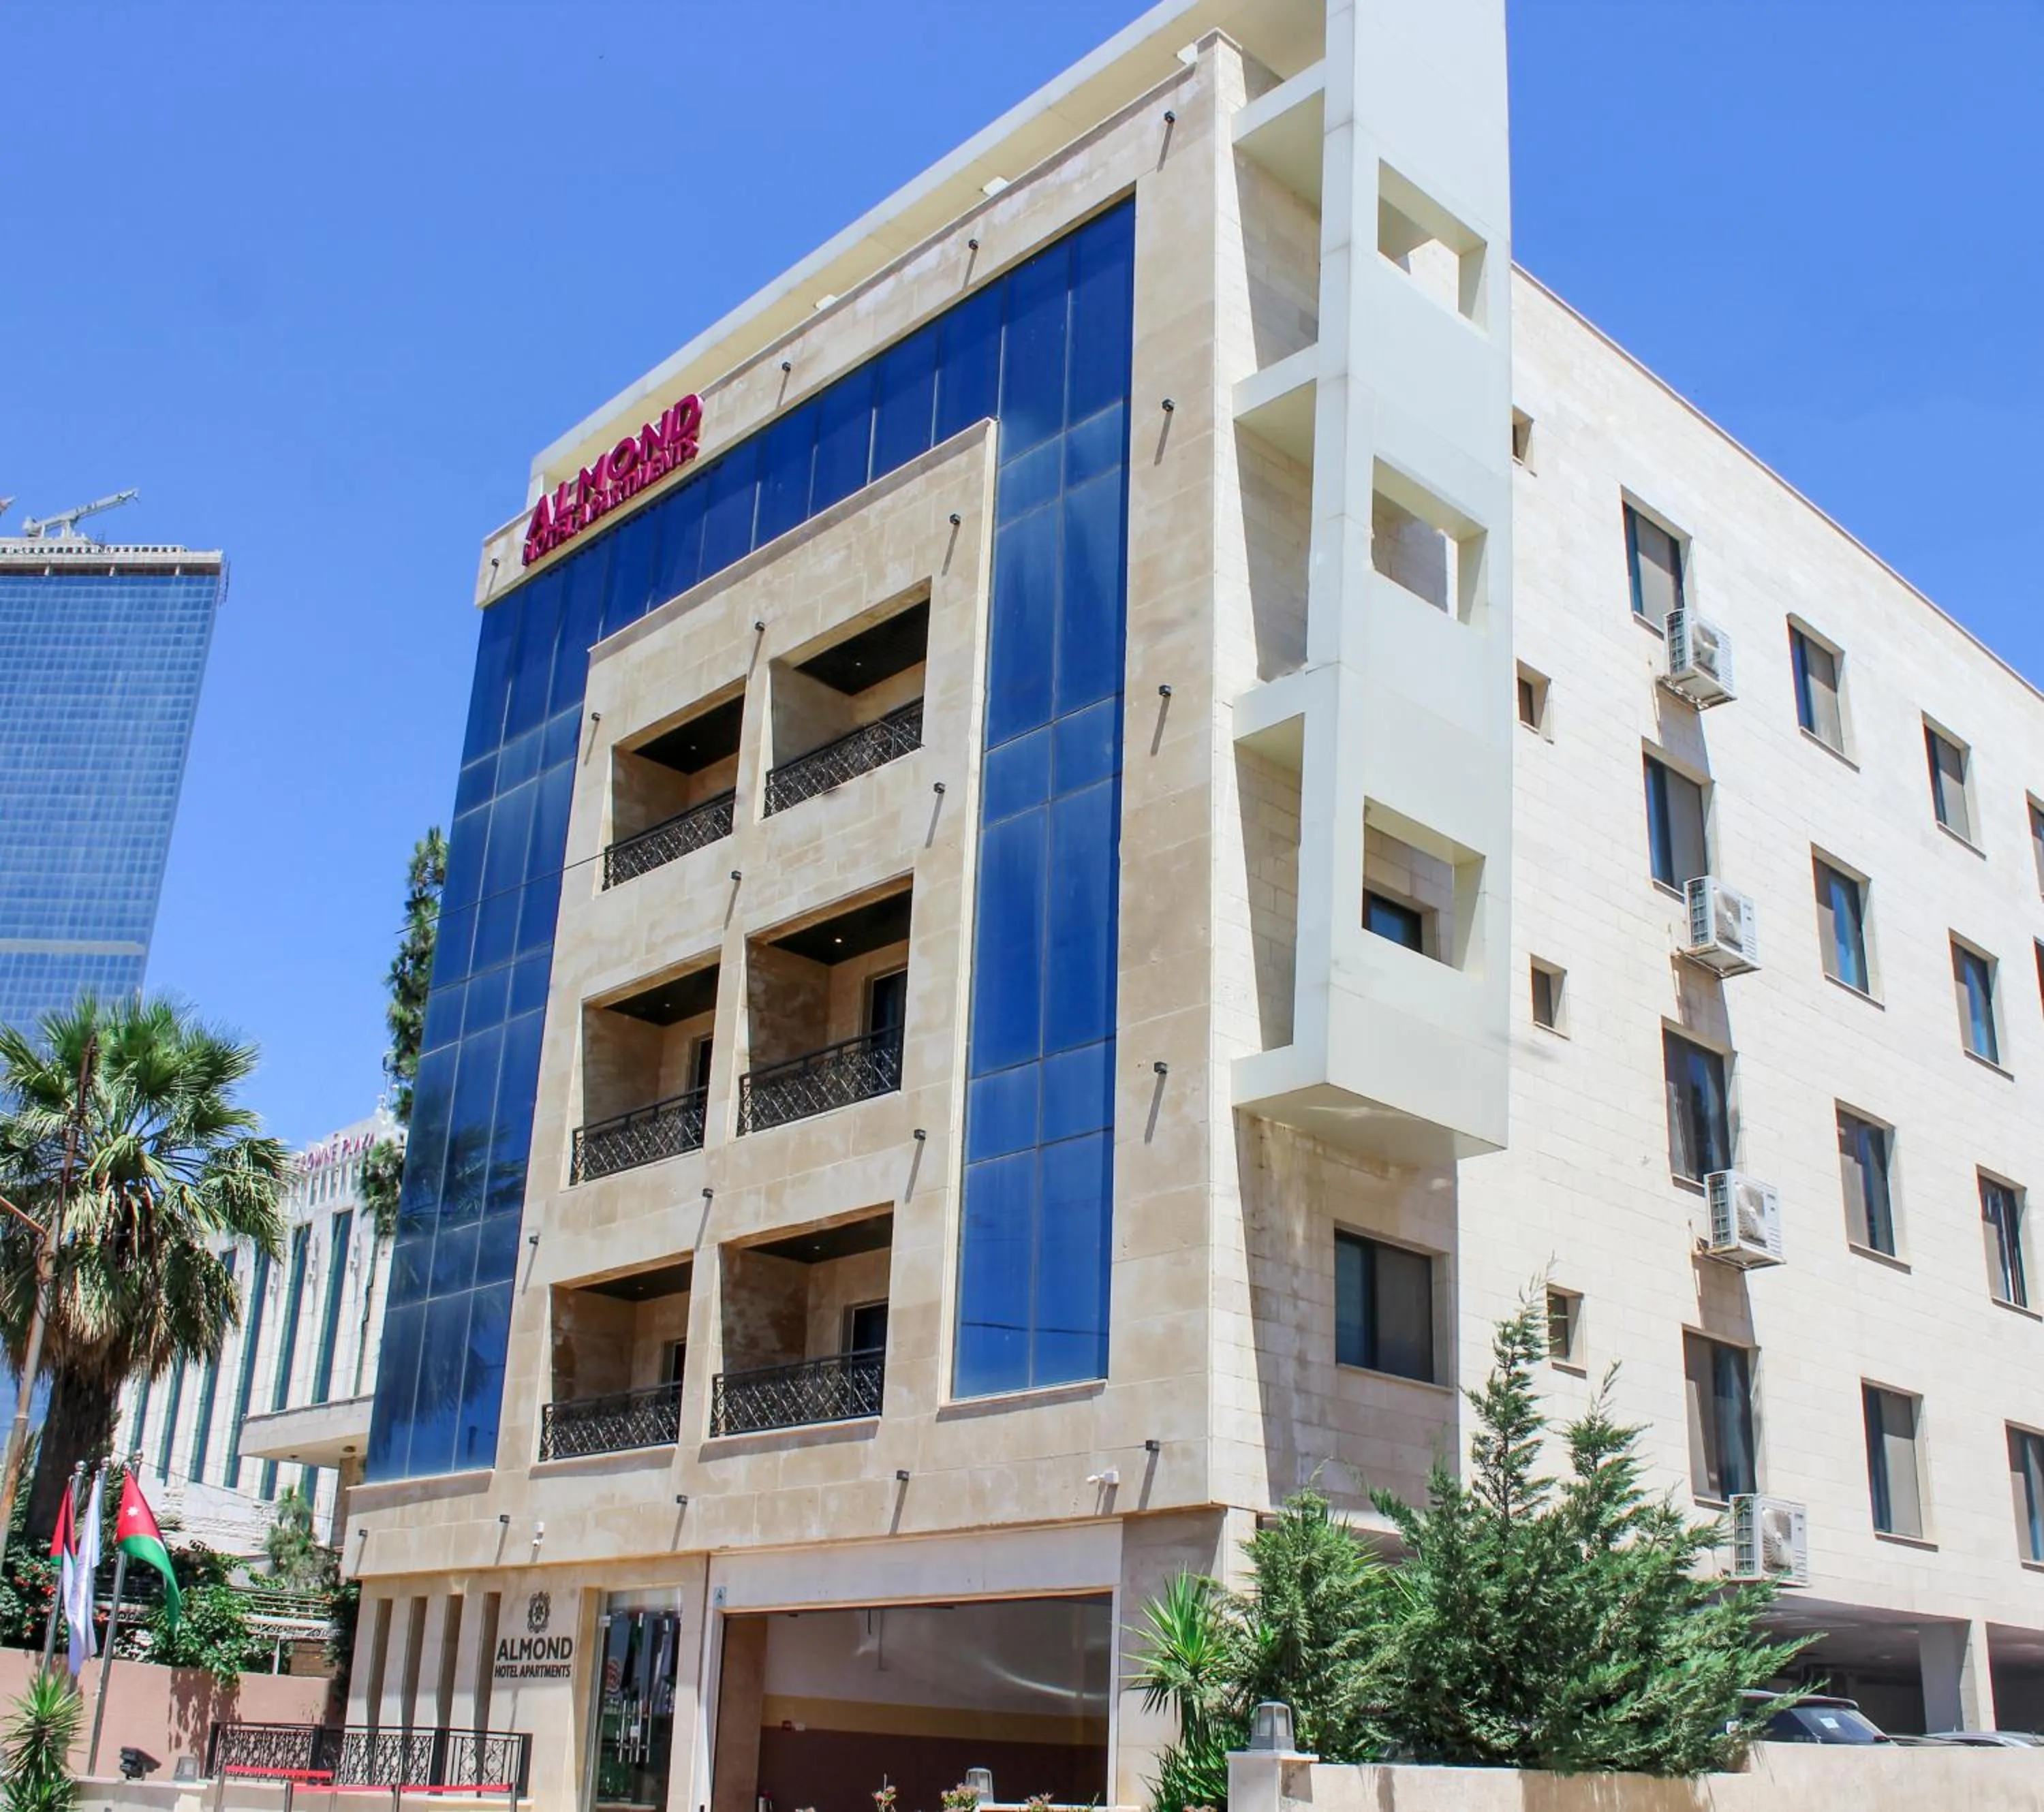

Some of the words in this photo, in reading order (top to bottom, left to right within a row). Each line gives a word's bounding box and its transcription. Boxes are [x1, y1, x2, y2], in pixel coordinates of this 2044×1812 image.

[525, 393, 704, 541] ALMOND
[497, 1636, 573, 1661] ALMOND
[495, 1664, 518, 1678] HOTEL
[518, 1664, 572, 1678] APARTMENTS
